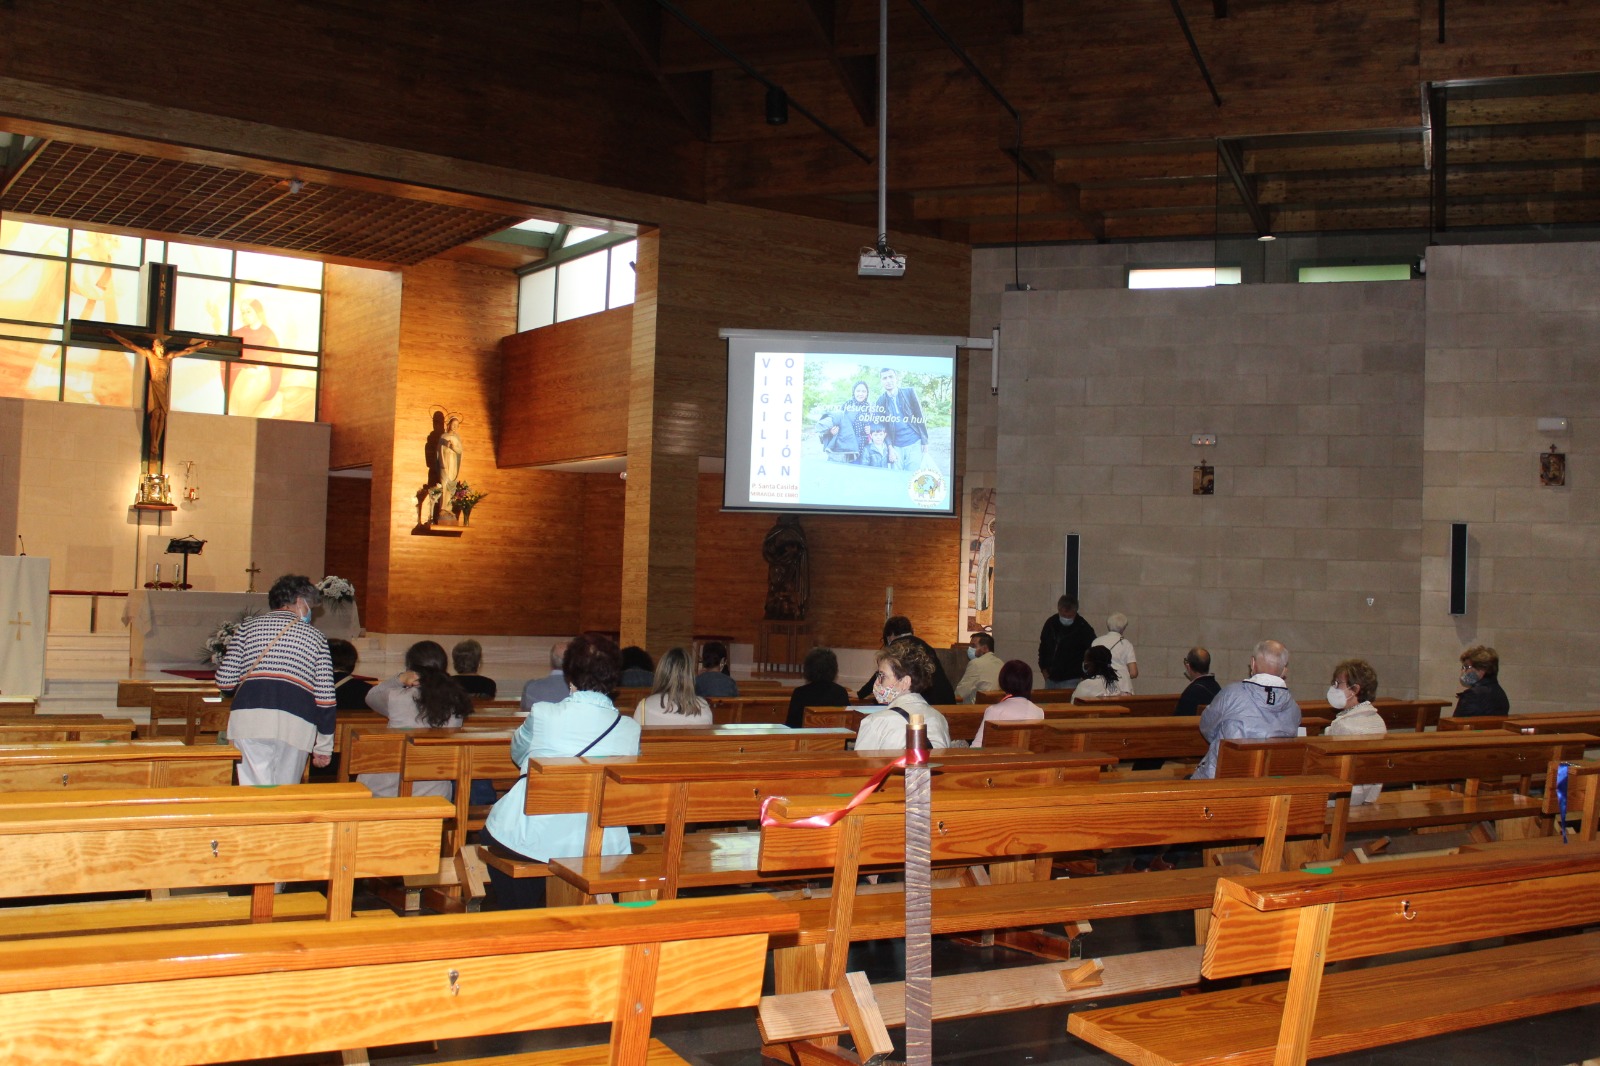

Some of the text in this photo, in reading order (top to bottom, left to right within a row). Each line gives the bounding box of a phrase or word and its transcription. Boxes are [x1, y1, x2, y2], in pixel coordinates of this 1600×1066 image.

[159, 273, 167, 306] INRI
[757, 357, 771, 476] VIGILIA
[781, 357, 795, 477] ORACIÓN
[858, 413, 901, 424] obligados
